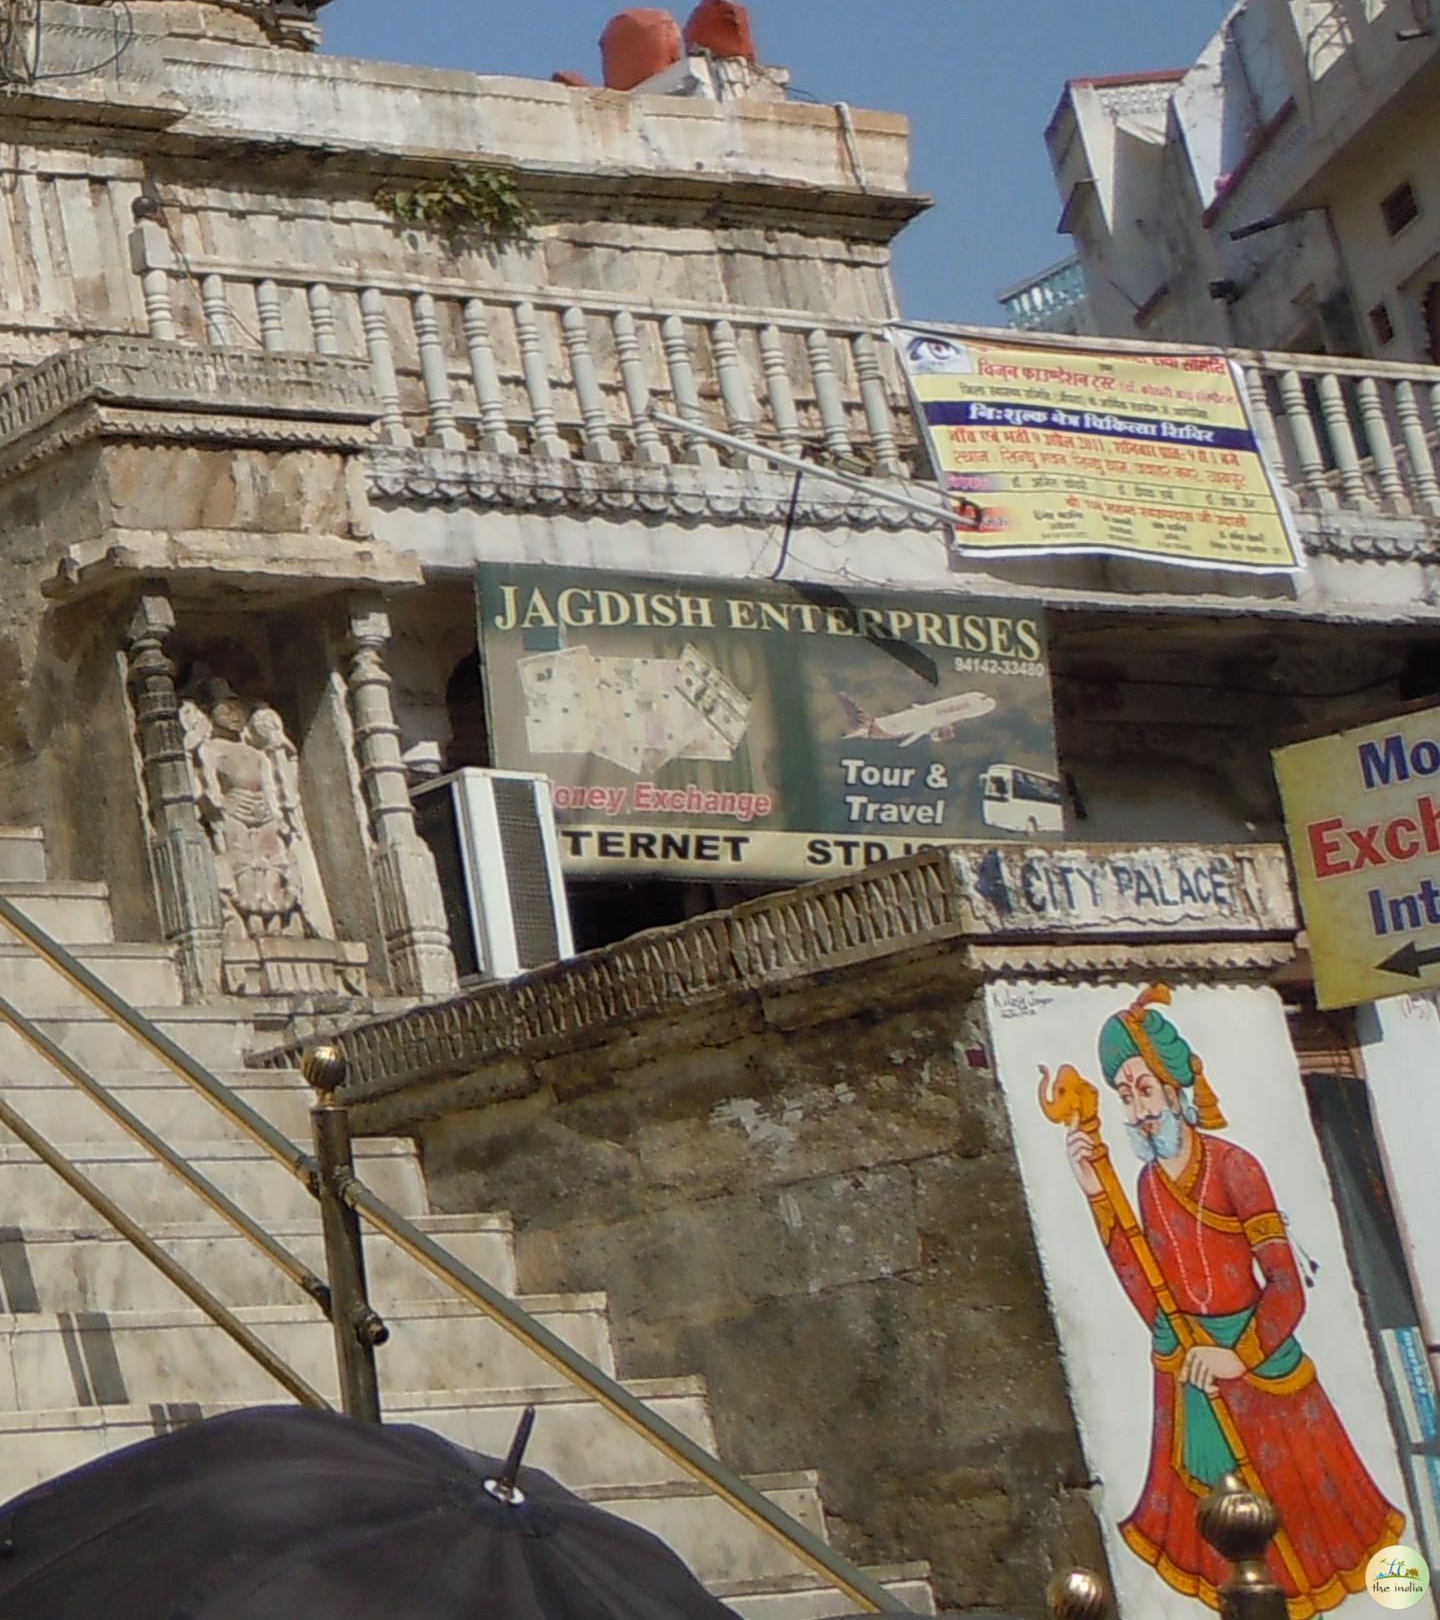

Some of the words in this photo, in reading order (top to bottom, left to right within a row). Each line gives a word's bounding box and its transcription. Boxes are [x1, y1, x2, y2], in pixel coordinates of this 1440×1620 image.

[495, 584, 716, 631] JAGDISH
[725, 599, 1042, 662] ENTERPRISES
[841, 759, 915, 788] Tour
[927, 763, 949, 789] &
[1358, 735, 1440, 789] Mo
[552, 784, 627, 815] oney
[633, 781, 772, 822] Exchange
[845, 796, 945, 825] Travel
[561, 830, 750, 862] TERNET
[806, 839, 889, 867] STD
[1308, 796, 1440, 878] Exch
[1022, 861, 1099, 912] CITY
[1115, 861, 1233, 907] PALACE
[1368, 879, 1440, 936] Int
